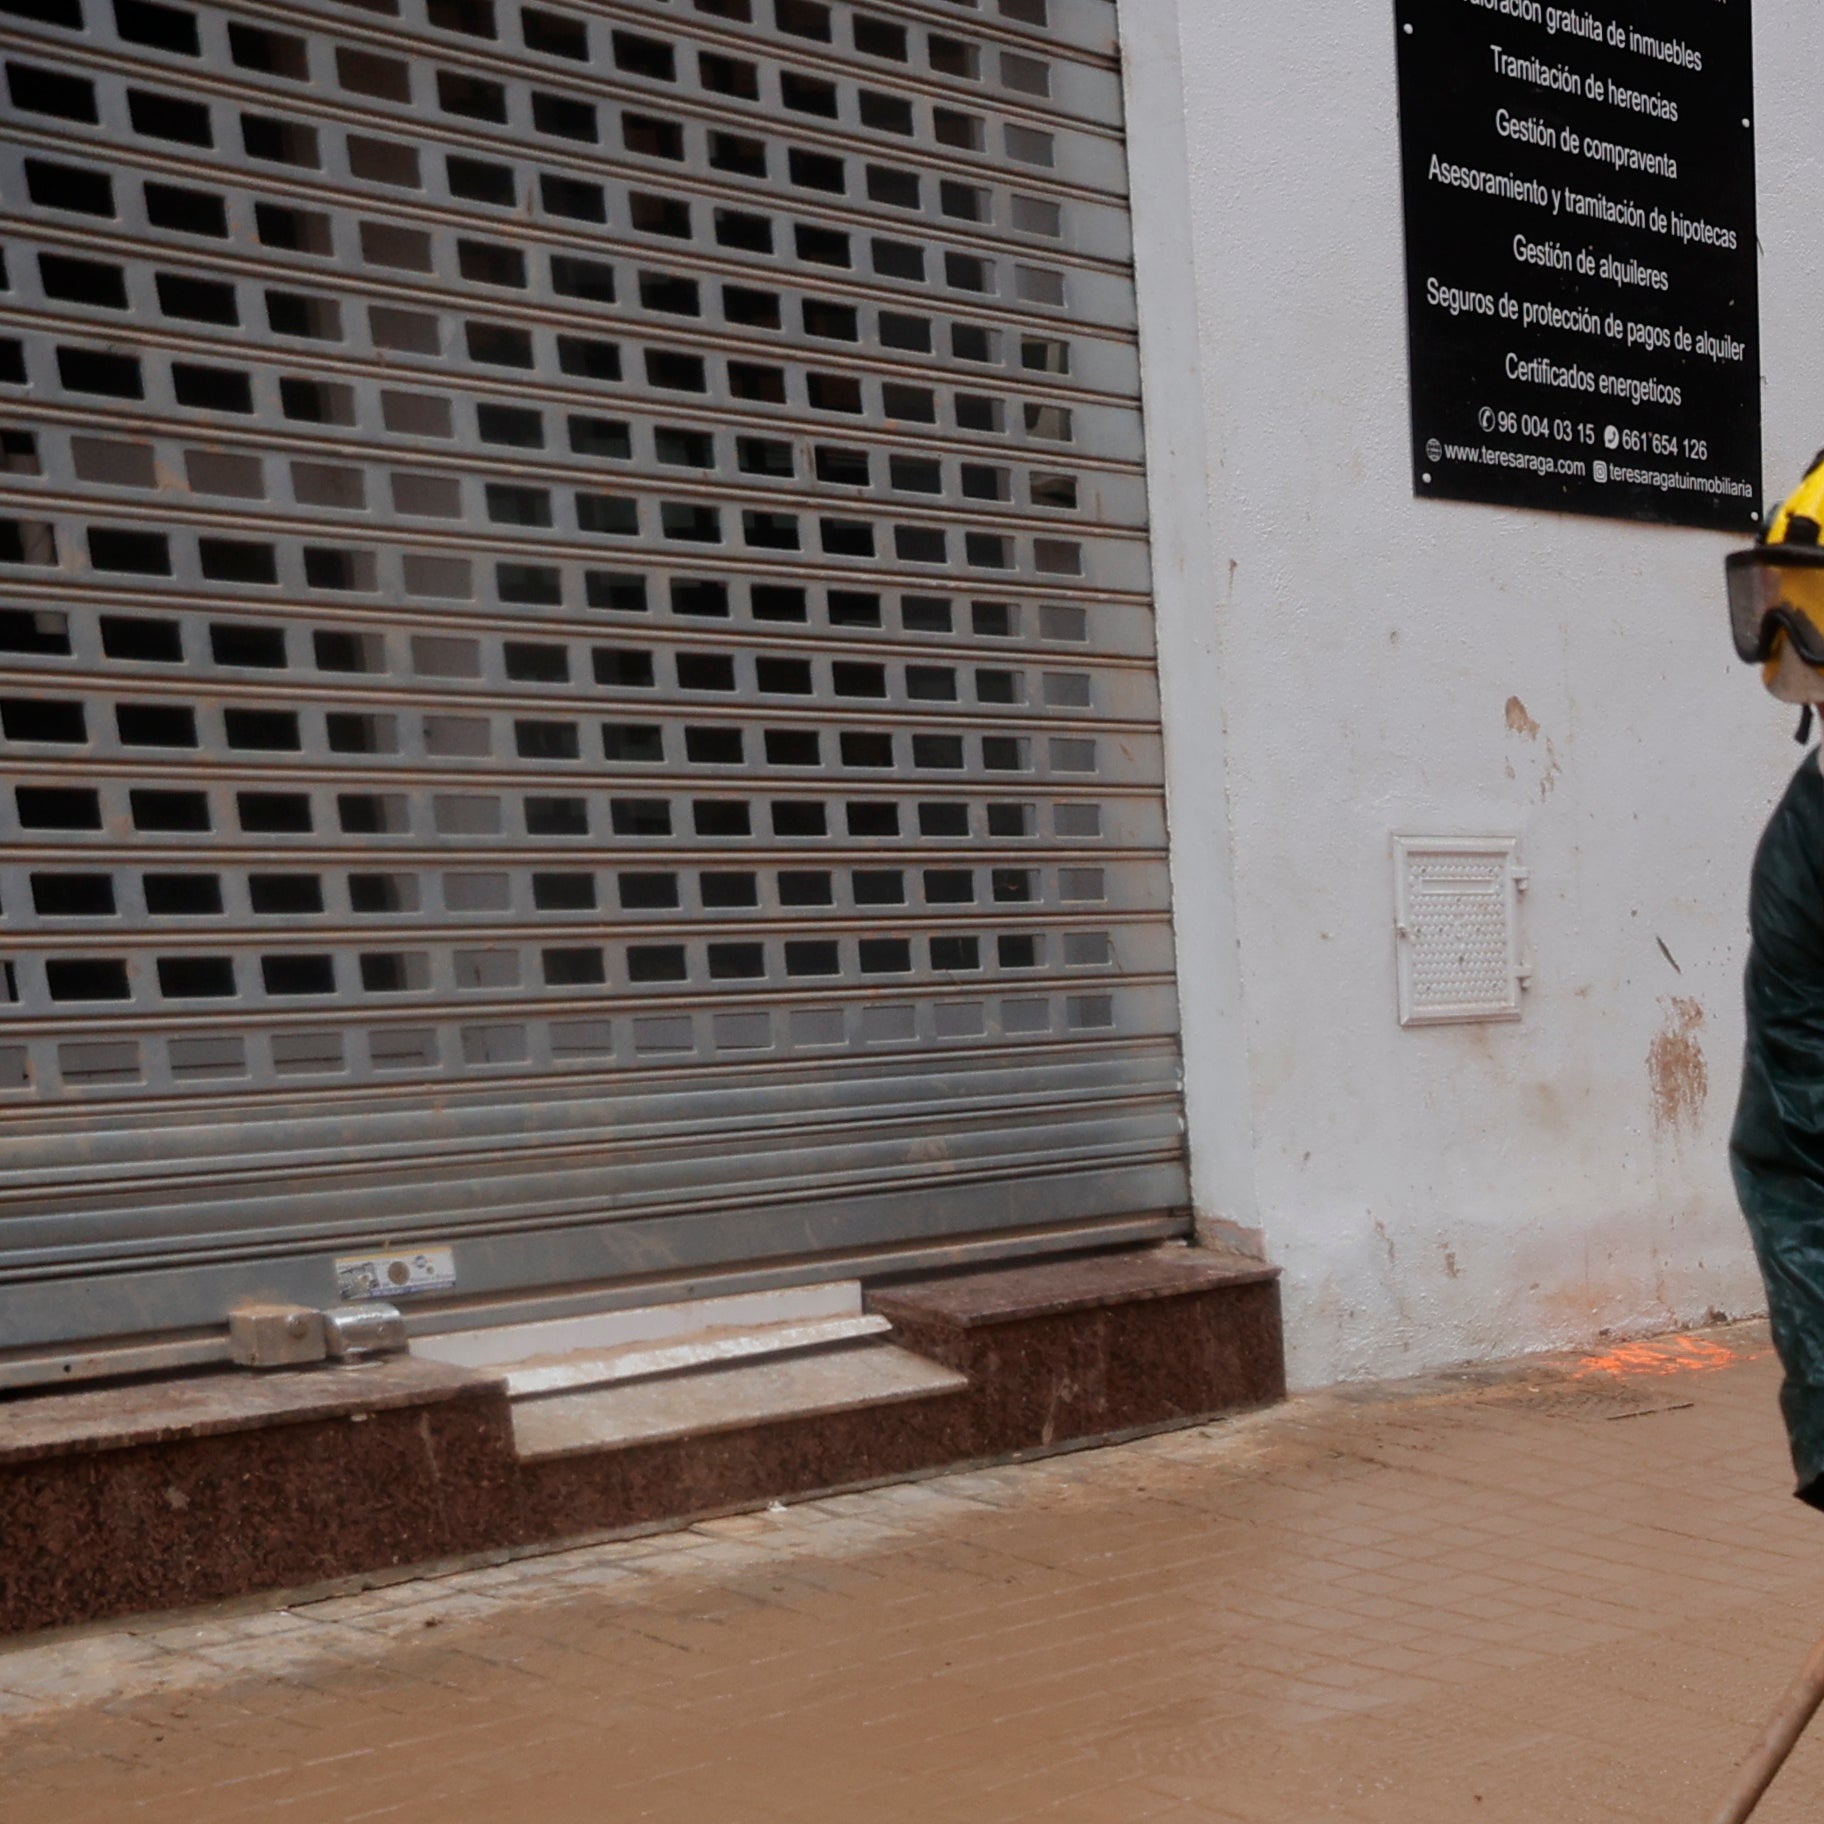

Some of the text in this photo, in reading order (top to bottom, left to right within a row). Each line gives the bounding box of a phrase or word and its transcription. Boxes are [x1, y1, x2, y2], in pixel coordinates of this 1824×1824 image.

[1546, 7, 1603, 42] gratuita
[1606, 21, 1627, 48] de
[1629, 25, 1703, 71] inmuebles
[1490, 45, 1678, 122] Tramitación de herencias
[1495, 108, 1678, 180] Gestión de compraventa
[1428, 153, 1737, 250] Asesoramiento y tramitación de hipotecas
[1513, 234, 1669, 291] Gestión de alquileres
[1426, 276, 1745, 361] Seguros de protección de pagos de alquiler
[1505, 352, 1682, 406] Certificados energeticos
[1497, 410, 1708, 461] 96 004 03 15 661 654 126
[1444, 443, 1753, 498] www.teresaraga.com teresaragatuinmobiliaria
